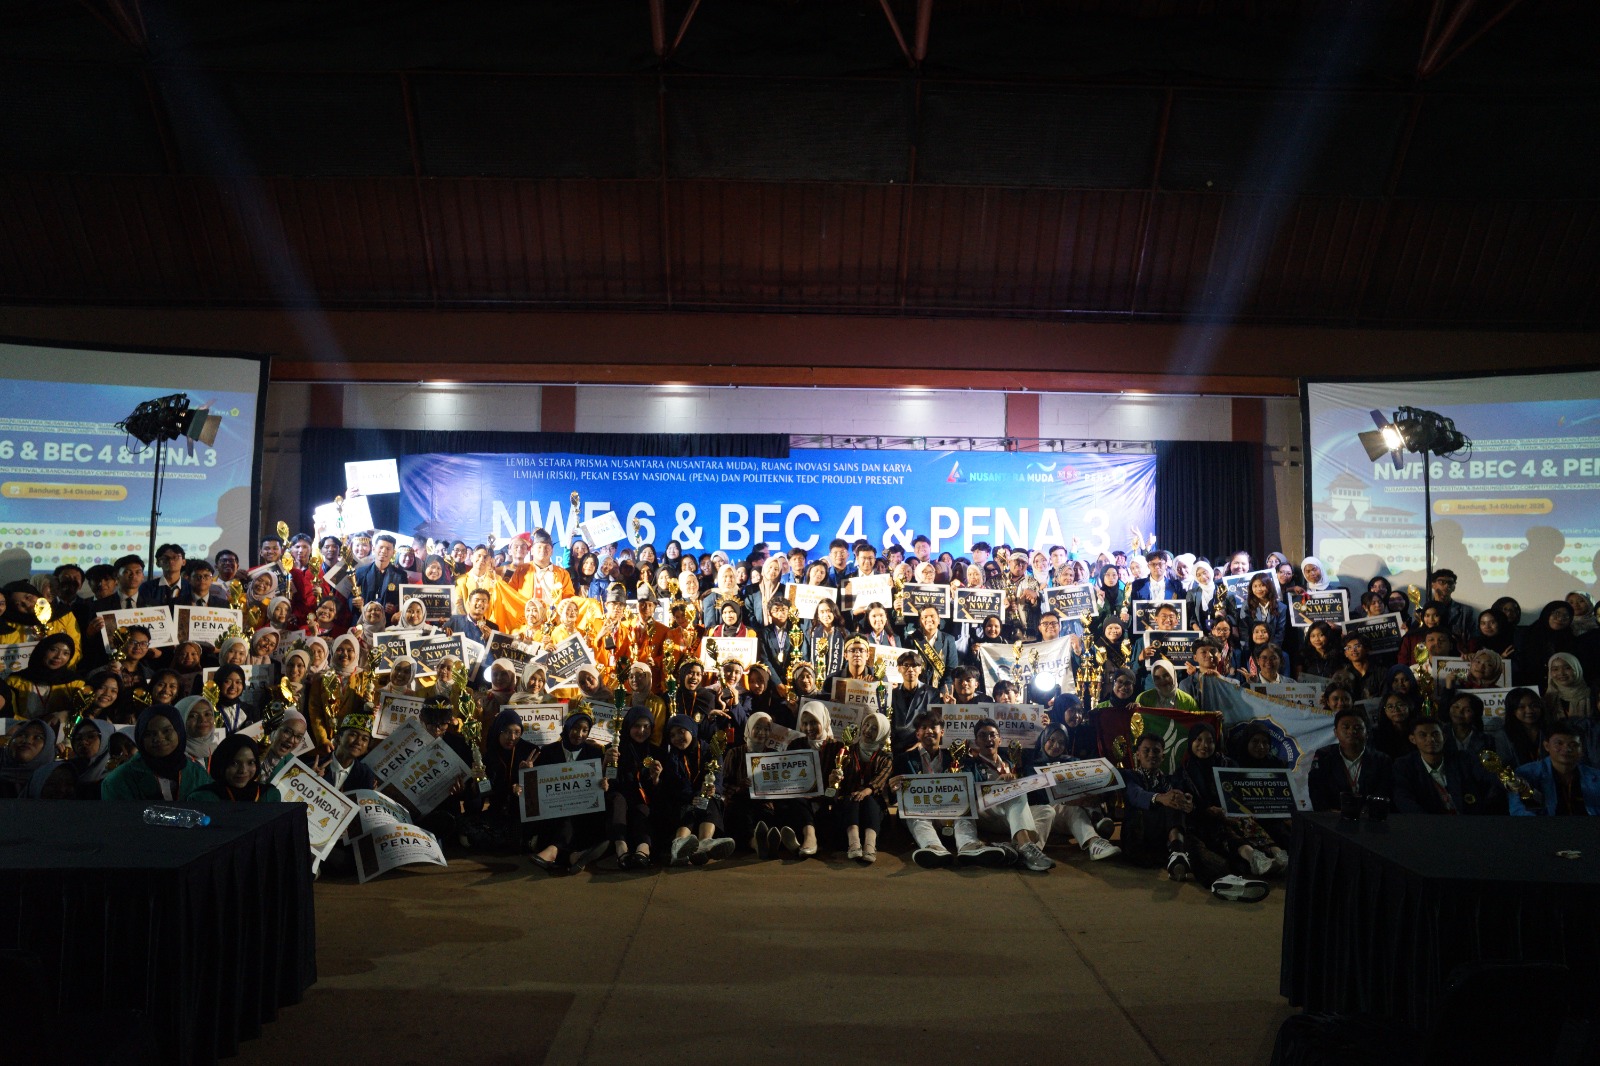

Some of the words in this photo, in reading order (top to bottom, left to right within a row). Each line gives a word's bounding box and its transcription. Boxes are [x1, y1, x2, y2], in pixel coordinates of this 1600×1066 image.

[0, 440, 14, 459] 6
[20, 441, 38, 460] &
[43, 442, 93, 462] BEC
[98, 445, 113, 463] 4
[117, 446, 134, 464] &
[204, 449, 217, 467] 3
[506, 458, 536, 467] LEMBA
[538, 459, 572, 467] SETARA
[574, 459, 608, 468] PRISMA
[611, 460, 664, 469] NUSANTARA
[666, 461, 723, 470] (NUSANTARA
[726, 462, 759, 471] MUDA),
[761, 463, 792, 471] RUANG
[795, 463, 831, 471] INOVASI
[833, 463, 859, 472] SAINS
[861, 464, 880, 472] DAN
[883, 464, 912, 473] KARYA
[1374, 461, 1424, 480] NWF
[1429, 461, 1443, 479] 6
[1449, 461, 1464, 479] &
[1469, 460, 1516, 478] BEC
[1521, 460, 1536, 477] 4
[1541, 459, 1558, 477] &
[513, 471, 543, 479] ILMIAH
[546, 471, 579, 481] (RISKI),
[581, 471, 610, 480] PEKAN
[612, 472, 639, 481] ESSAY
[642, 472, 687, 482] NASIONAL
[689, 473, 719, 483] (PENA)
[721, 473, 741, 482] DAN
[743, 474, 794, 483] POLITEKNIK
[796, 475, 819, 484] TEDC
[822, 475, 863, 484] PROUDLY
[865, 476, 904, 485] PRESENT
[1027, 473, 1054, 483] MUDA
[1501, 502, 1527, 510] Oktober
[626, 501, 656, 550] 6
[672, 503, 704, 550] &
[720, 503, 820, 551] BEC
[835, 505, 867, 550] 4
[882, 506, 914, 552] &
[930, 506, 1066, 554] PENA
[1083, 508, 1111, 555] 3
[915, 596, 936, 604] NWF
[967, 595, 993, 603] JUARA
[1059, 597, 1081, 608] NWF
[1085, 597, 1091, 605] 6
[994, 603, 999, 611] 6
[1306, 603, 1331, 612] NWF
[1336, 603, 1342, 611] 6
[194, 622, 224, 630] PENA
[426, 649, 450, 659] NWF
[455, 648, 461, 656] 6
[547, 645, 574, 666] JUARA
[575, 642, 581, 650] 2
[554, 655, 574, 670] NWF
[849, 695, 876, 704] PENA
[391, 705, 407, 713] BEST
[535, 713, 559, 721] MEDAL
[995, 712, 1028, 721] JUARA
[547, 722, 555, 731] 4
[946, 721, 975, 729] PENA
[998, 721, 1025, 729] PENA
[1029, 722, 1035, 730] 3
[381, 747, 414, 777] PENA
[414, 737, 424, 747] 3
[782, 760, 808, 769] PAPER
[402, 758, 438, 789] JUARA
[410, 768, 440, 793] PENA
[441, 759, 449, 767] 3
[560, 772, 589, 781] HARAPAN
[763, 770, 791, 780] BEC
[799, 768, 807, 778] 4
[1055, 770, 1086, 781] BEC
[545, 781, 580, 793] PENA
[585, 779, 592, 788] 3
[910, 785, 934, 794] GOLD
[935, 784, 964, 793] MEDAL
[1241, 787, 1275, 797] NWF
[1282, 788, 1290, 797] 6
[290, 778, 315, 799] GOLD
[313, 795, 341, 820] MEDAL
[913, 794, 943, 805] BEC
[951, 793, 960, 803] 4
[364, 805, 399, 818] PENA
[318, 817, 330, 828] 4
[375, 831, 401, 843] GOLD
[403, 831, 433, 843] MEDAL
[380, 837, 421, 851] PENA
[425, 840, 432, 848] 3
